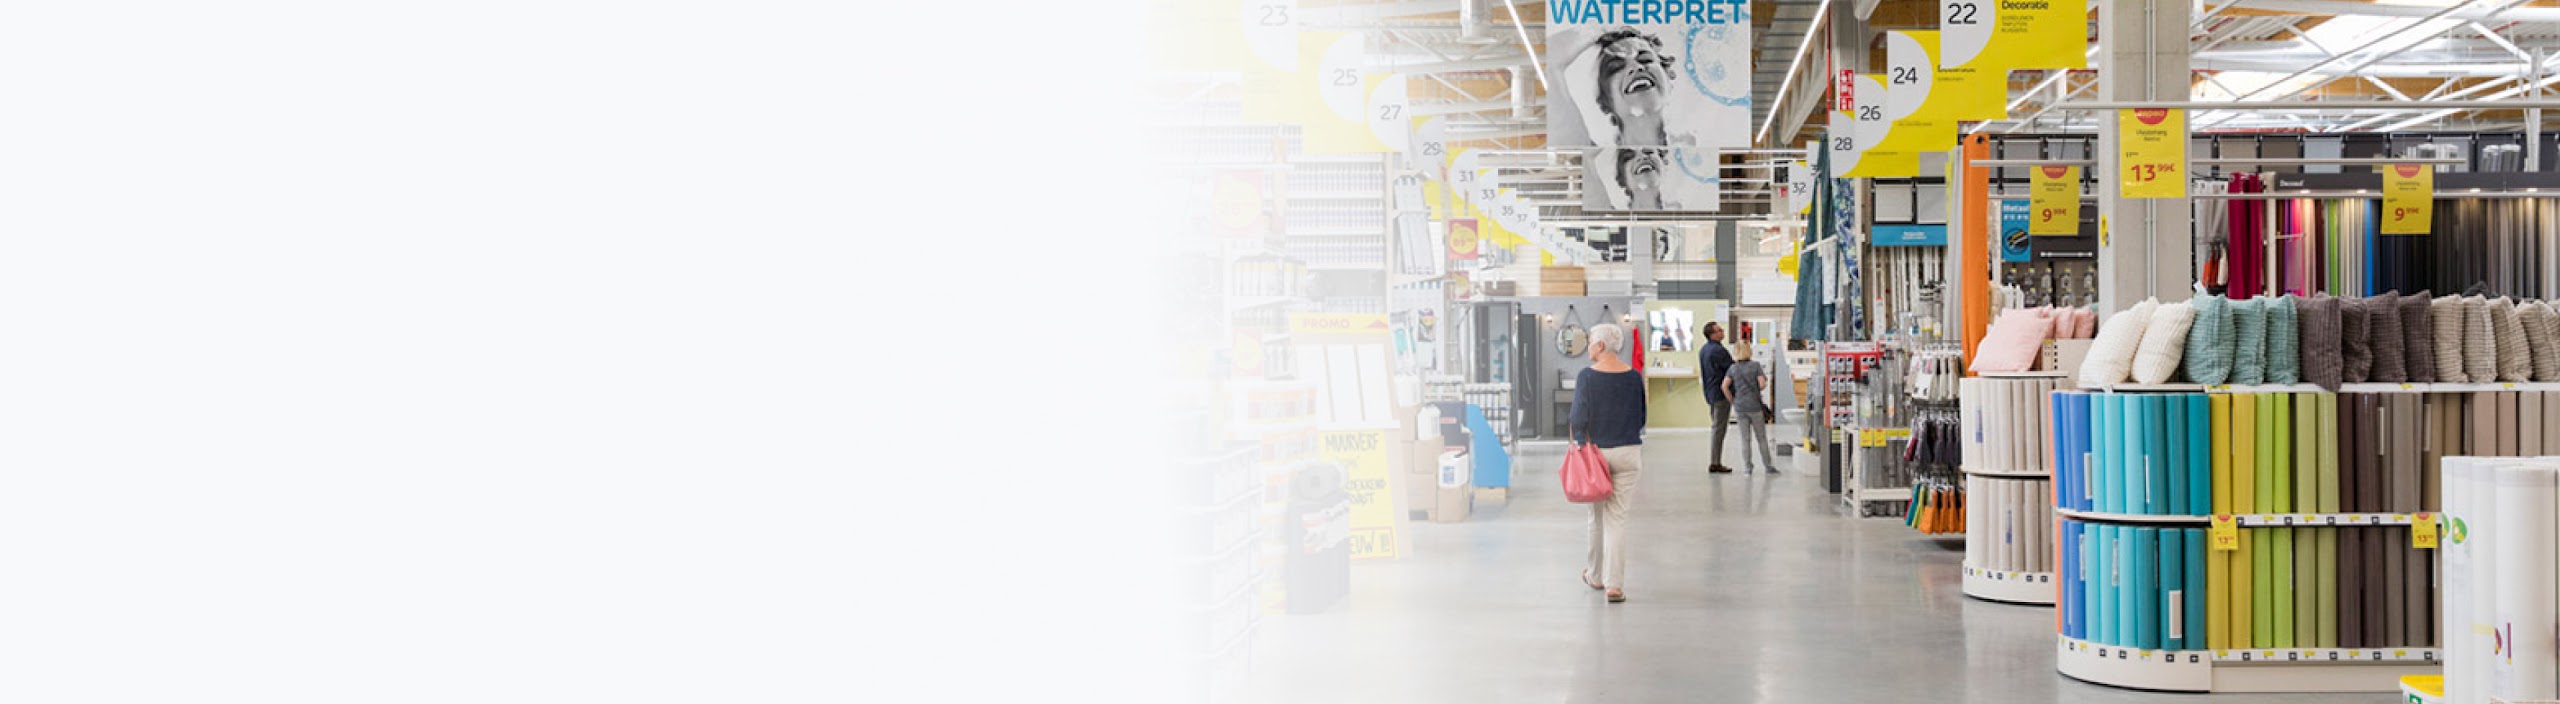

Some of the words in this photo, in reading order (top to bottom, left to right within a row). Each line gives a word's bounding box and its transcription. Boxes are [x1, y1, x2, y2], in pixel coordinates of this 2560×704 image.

[1259, 4, 1289, 26] 23
[1550, 0, 1748, 25] WATERPRET
[1947, 3, 1977, 25] 22
[1333, 68, 1358, 86] 25
[1893, 66, 1918, 84] 24
[1380, 105, 1401, 120] 27
[1859, 105, 1882, 120] 26
[1423, 142, 1441, 156] 29
[1834, 137, 1853, 151] 28
[1458, 170, 1474, 182] 31
[2130, 164, 2156, 181] 13
[1481, 189, 1495, 200] 33
[1792, 183, 1806, 193] 32
[2042, 208, 2052, 222] 9
[2394, 206, 2405, 221] 9
[1302, 318, 1351, 329] PROMO
